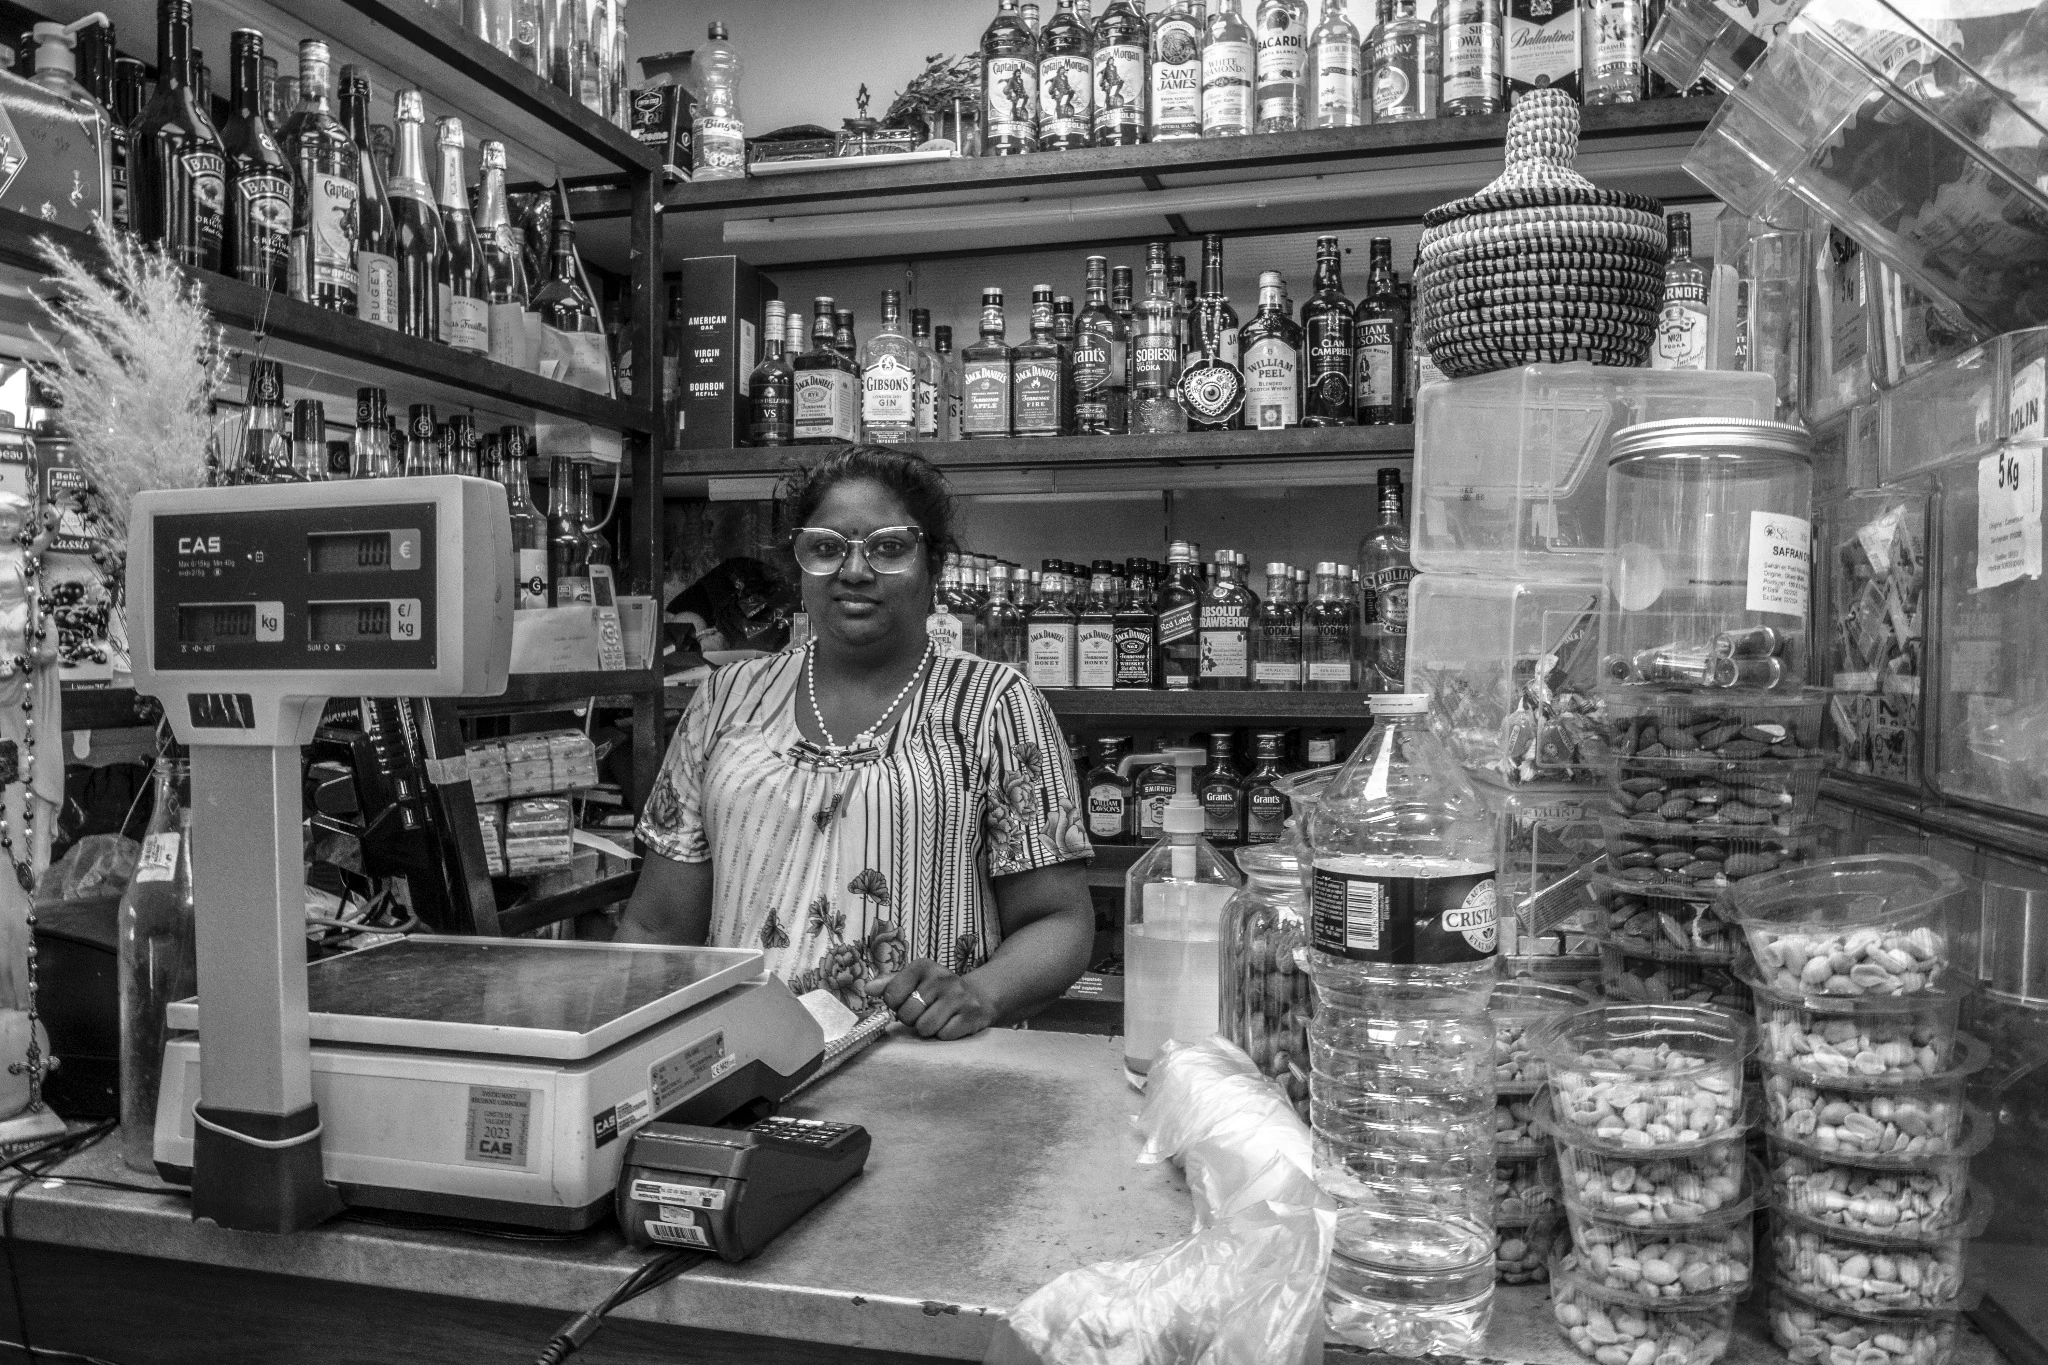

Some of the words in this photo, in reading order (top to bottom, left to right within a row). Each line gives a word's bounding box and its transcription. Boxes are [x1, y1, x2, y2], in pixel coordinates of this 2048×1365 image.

[1511, 28, 1575, 49] Ballantine's
[1113, 48, 1141, 62] Morgan
[993, 62, 1019, 75] Captain
[1065, 59, 1090, 74] Morgan
[1160, 68, 1197, 80] SAINT
[1157, 79, 1197, 92] JAMES
[371, 268, 380, 321] BUGEY
[688, 315, 727, 326] AMERICAN
[1321, 338, 1345, 349] CLAN
[694, 348, 720, 358] VIRGIN
[1136, 347, 1178, 362] SOBIESKI
[1311, 347, 1352, 357] CAMPBELL
[1136, 364, 1161, 373] VODKA
[1246, 358, 1294, 373] WILLIAM
[964, 370, 981, 385] JACK
[981, 367, 1008, 384] DANIEL'S
[1015, 368, 1032, 384] JACK
[1032, 365, 1058, 382] DANIEL'S
[1258, 368, 1285, 379] PEEL
[689, 381, 725, 392] BOURBON
[795, 380, 810, 393] JACK
[810, 375, 834, 391] DANIEL'S
[878, 399, 897, 407] GIN
[1021, 394, 1051, 402] Tennessee
[763, 409, 777, 418] VS
[1998, 451, 2005, 489] 5
[2007, 456, 2019, 491] Kg
[50, 535, 91, 551] Cassis
[178, 536, 221, 554] CAS
[1772, 545, 1803, 561] SAFRAN
[1201, 605, 1243, 617] ABSOLUT
[261, 613, 278, 632] kg
[397, 620, 414, 637] kg
[1160, 621, 1174, 631] Red
[1174, 613, 1193, 626] Label
[1030, 631, 1043, 643] JACK
[1043, 629, 1065, 643] DANIEL'S
[1080, 631, 1093, 643] JACK
[1093, 629, 1114, 643] DANIEL'S
[1114, 631, 1129, 644] JACK
[1128, 629, 1151, 644] DANIEL'S
[1263, 626, 1294, 636] VODKA
[1317, 626, 1350, 636] VODKA
[203, 644, 216, 652] NET
[307, 643, 321, 652] SUM
[1144, 785, 1176, 793] SMIRNOFF
[1206, 792, 1233, 801] Grant's
[1253, 794, 1280, 804] Grant's
[1091, 804, 1121, 813] LAWSON'S
[595, 1115, 616, 1134] CAS
[483, 1125, 511, 1140] 2023
[479, 1139, 513, 1156] CAS
